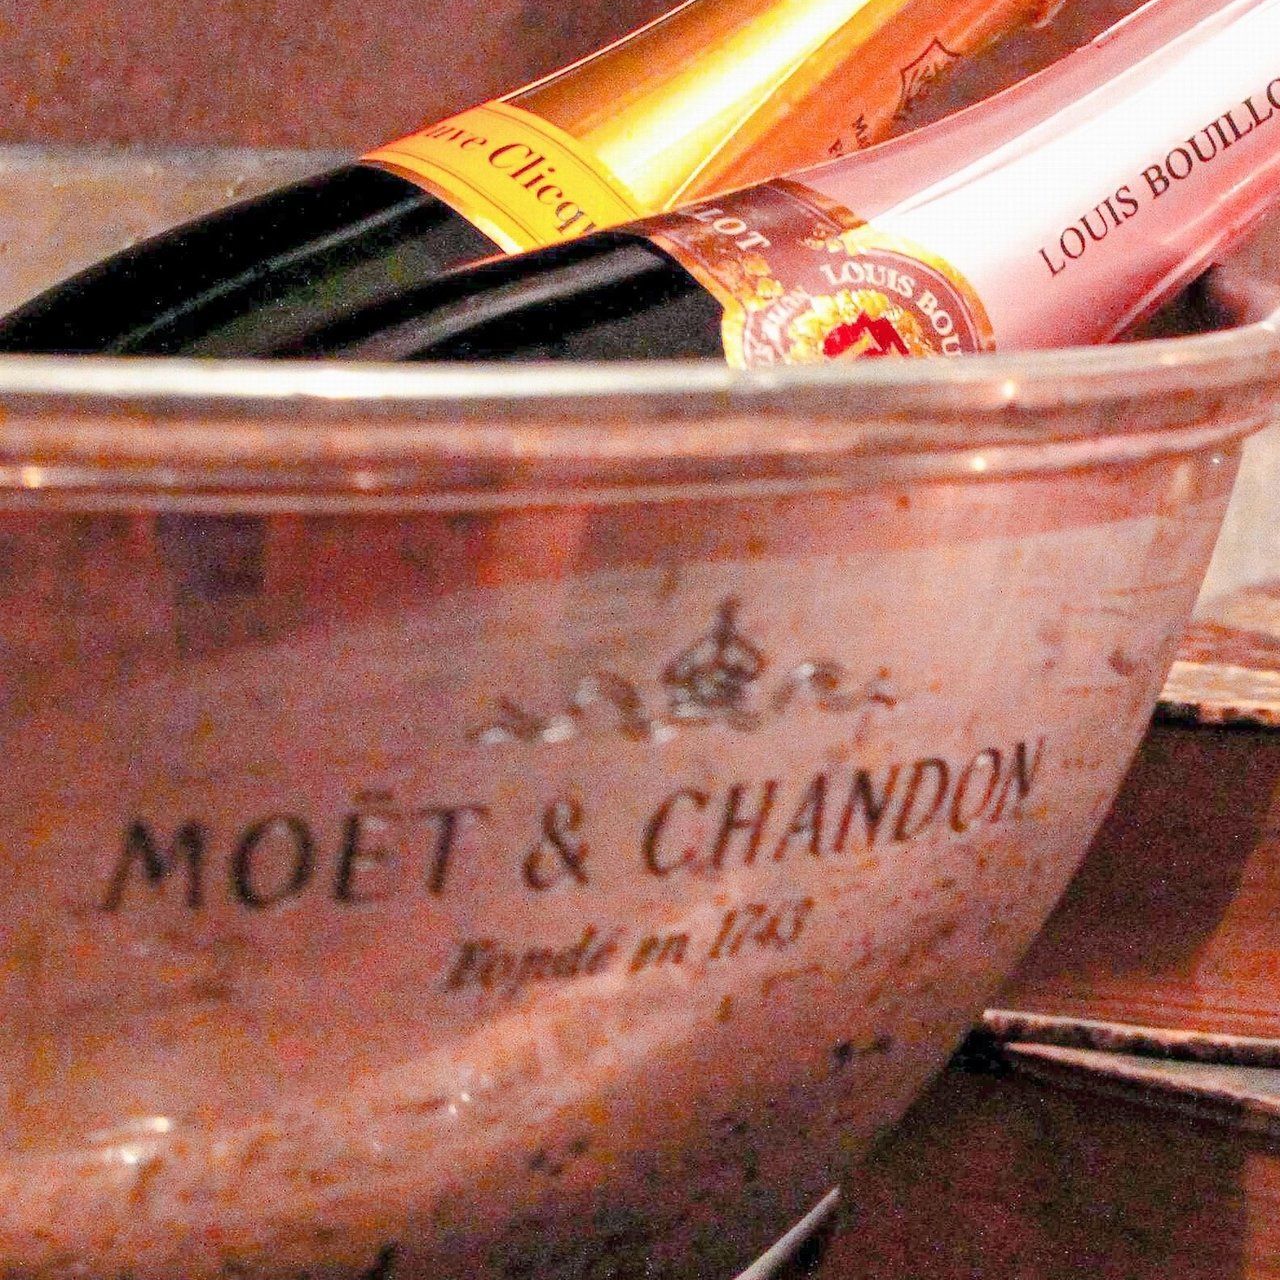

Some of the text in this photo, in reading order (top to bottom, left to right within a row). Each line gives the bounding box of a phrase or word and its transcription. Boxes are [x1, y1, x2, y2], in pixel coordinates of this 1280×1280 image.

[1038, 185, 1140, 278] LOUIS
[819, 260, 917, 299] LOUIS
[98, 734, 1050, 913] MOËT & CHANDON
